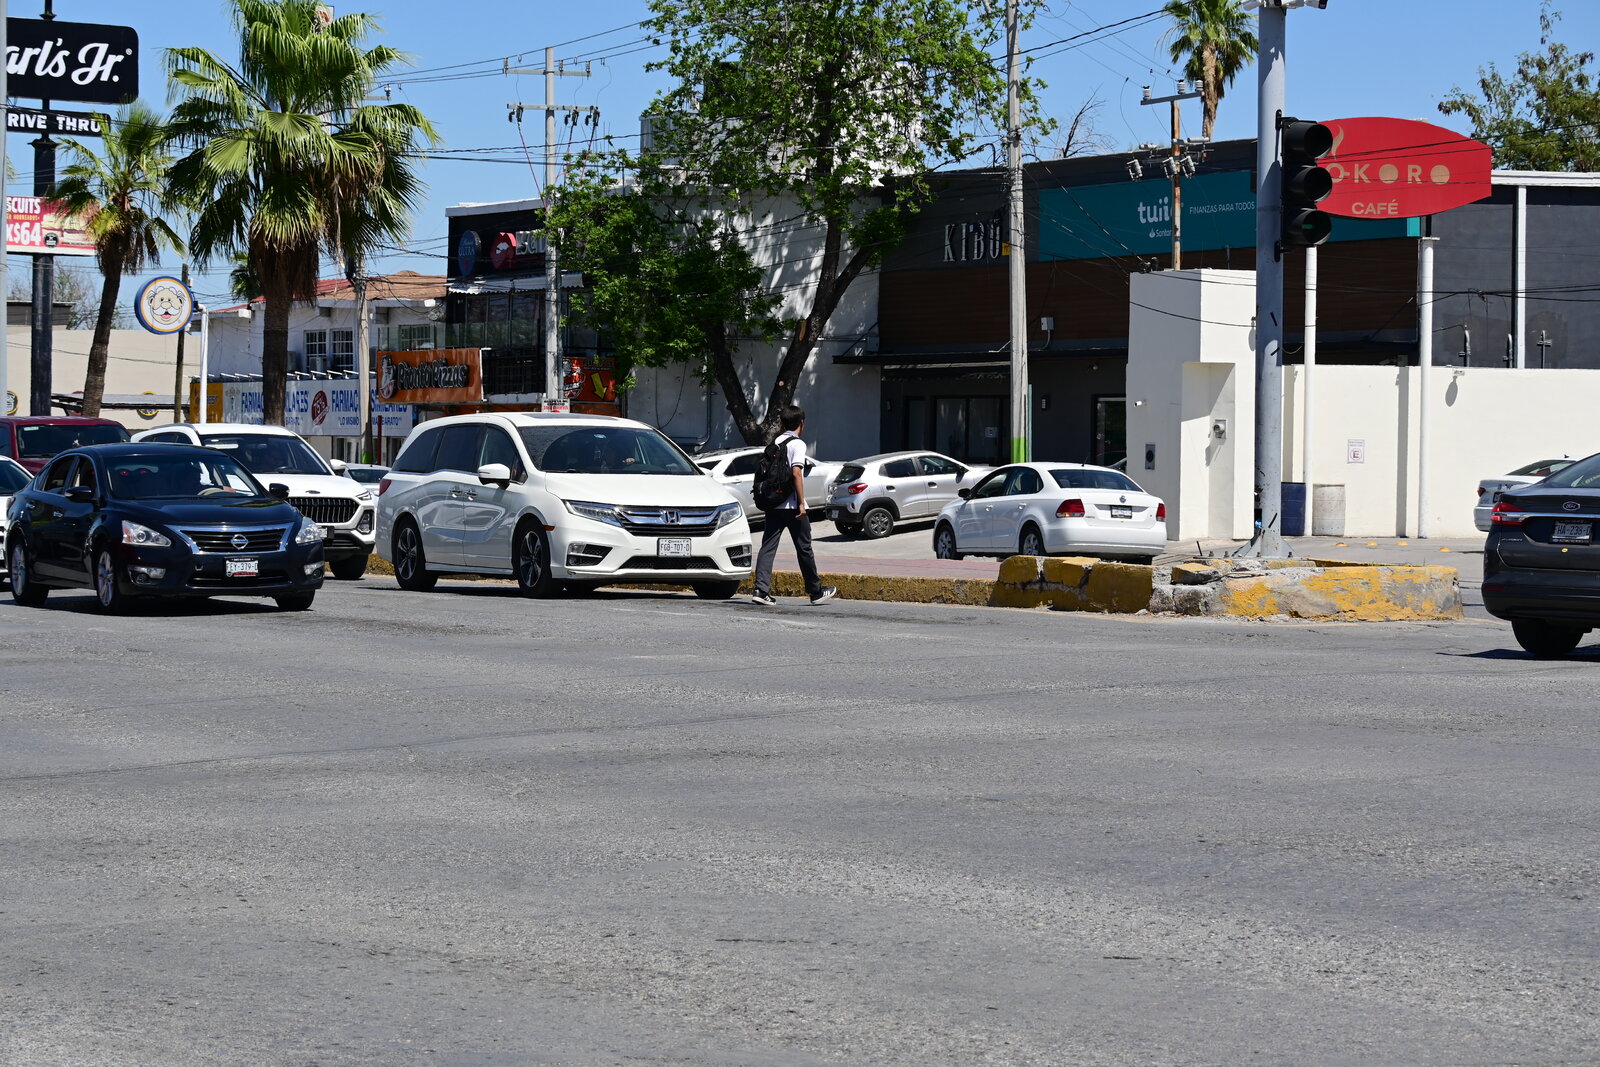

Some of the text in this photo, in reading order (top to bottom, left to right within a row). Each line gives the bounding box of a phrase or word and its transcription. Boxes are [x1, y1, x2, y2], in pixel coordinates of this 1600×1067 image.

[6, 38, 70, 78] arl's
[8, 113, 102, 133] RIVE THRU
[6, 197, 41, 214] SCUITS
[1137, 196, 1173, 224] tuii
[1189, 201, 1255, 215] FINANZAS PARA TODOS
[1351, 199, 1399, 215] CAFÉ
[241, 392, 264, 412] FARMAC
[331, 390, 359, 412] FARMAC
